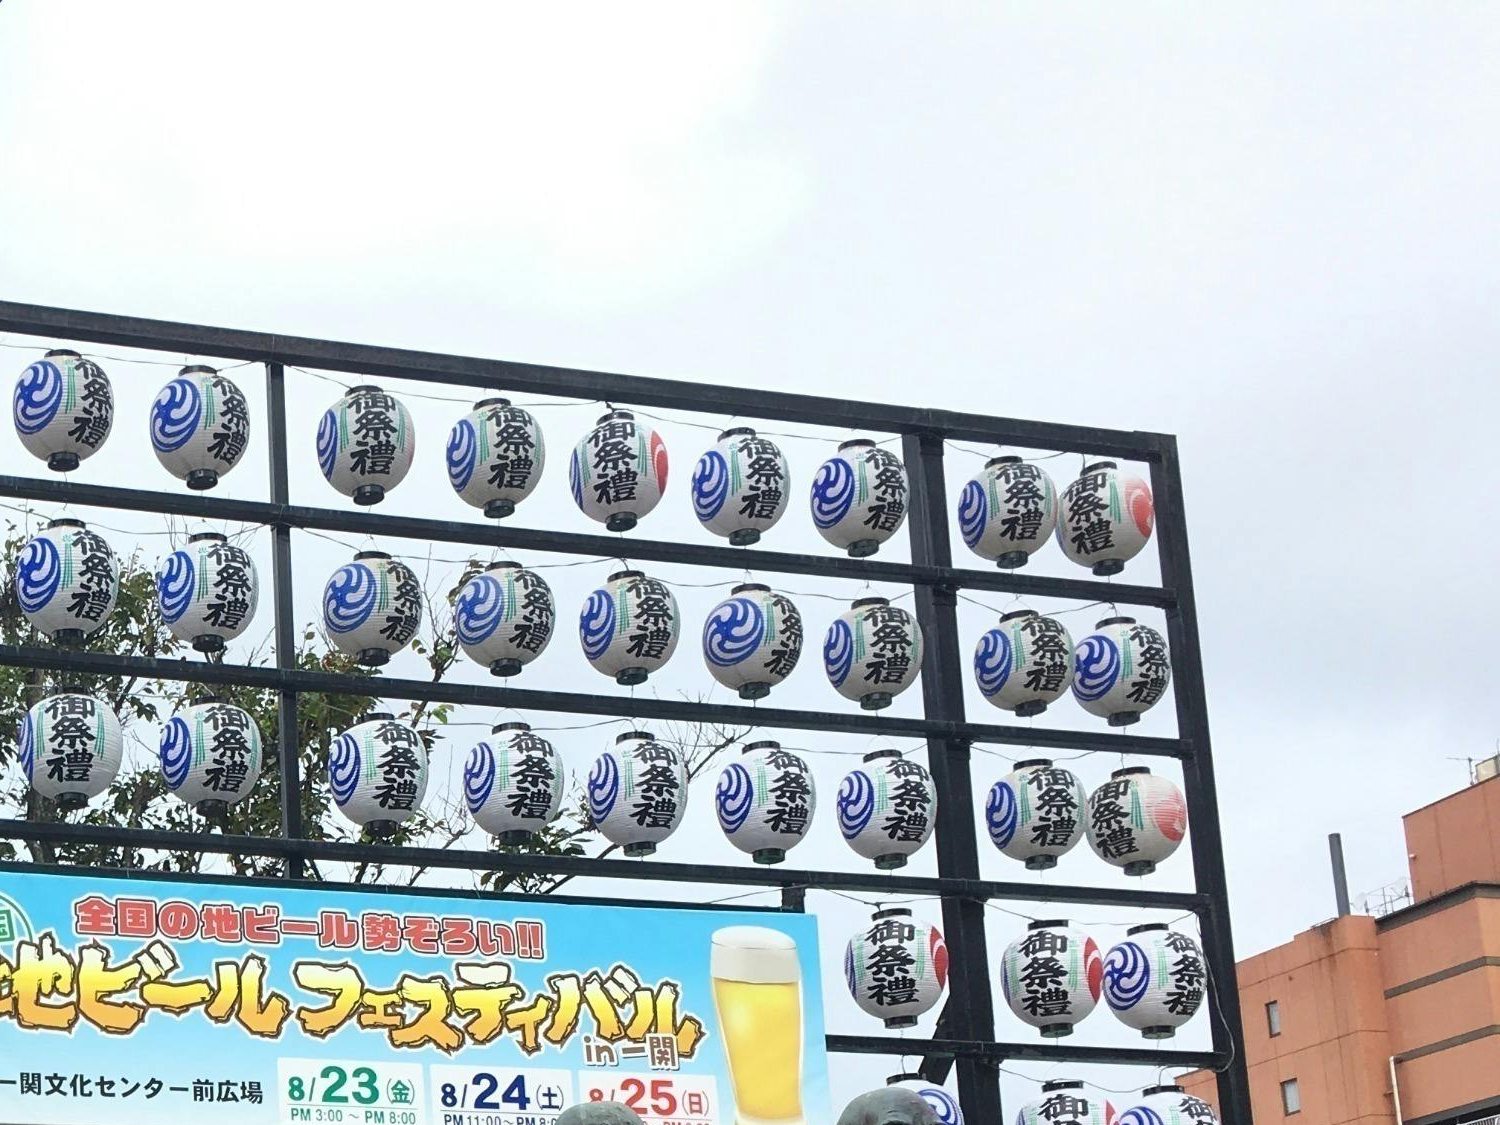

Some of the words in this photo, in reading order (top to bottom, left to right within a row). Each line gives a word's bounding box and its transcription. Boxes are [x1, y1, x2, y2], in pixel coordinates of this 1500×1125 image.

[71, 357, 113, 445] 御祭禮
[207, 374, 249, 465] 御祭禮
[345, 386, 396, 476] 御祭禮
[485, 399, 533, 490] 御祭禮
[589, 417, 637, 503] 御祭禮
[736, 435, 782, 521] 御祭禮
[864, 447, 909, 532] 御祭禮
[996, 464, 1045, 542] 御祭禮
[1063, 470, 1115, 554] 御祭禮
[69, 529, 116, 619] 御祭禮
[201, 544, 251, 630] 御祭禮
[377, 562, 422, 642] 御祭禮
[508, 569, 554, 651] 御祭禮
[624, 577, 671, 659] 御祭禮
[861, 606, 913, 684] 御祭禮
[1022, 615, 1067, 692] 御祭禮
[1124, 625, 1170, 702] 御祭禮
[43, 695, 96, 781] 御祭禮
[204, 705, 251, 792] 御祭禮
[372, 721, 420, 812] 御祭禮
[500, 732, 554, 821] 御祭禮
[631, 739, 679, 828] 御祭禮
[763, 747, 811, 835] 御祭禮
[885, 756, 932, 841] 御祭禮
[1028, 766, 1075, 847] 御祭禮
[864, 908, 917, 1005] 御祭禮
[1019, 927, 1071, 1016] 御祭禮
[1161, 930, 1204, 1016] 御祭禮
[584, 1036, 615, 1064] in
[621, 1036, 678, 1067] 一関
[290, 1108, 312, 1122] PM
[315, 1109, 343, 1123] 3:00
[364, 1109, 385, 1124] PM
[388, 1110, 416, 1125] 8:00
